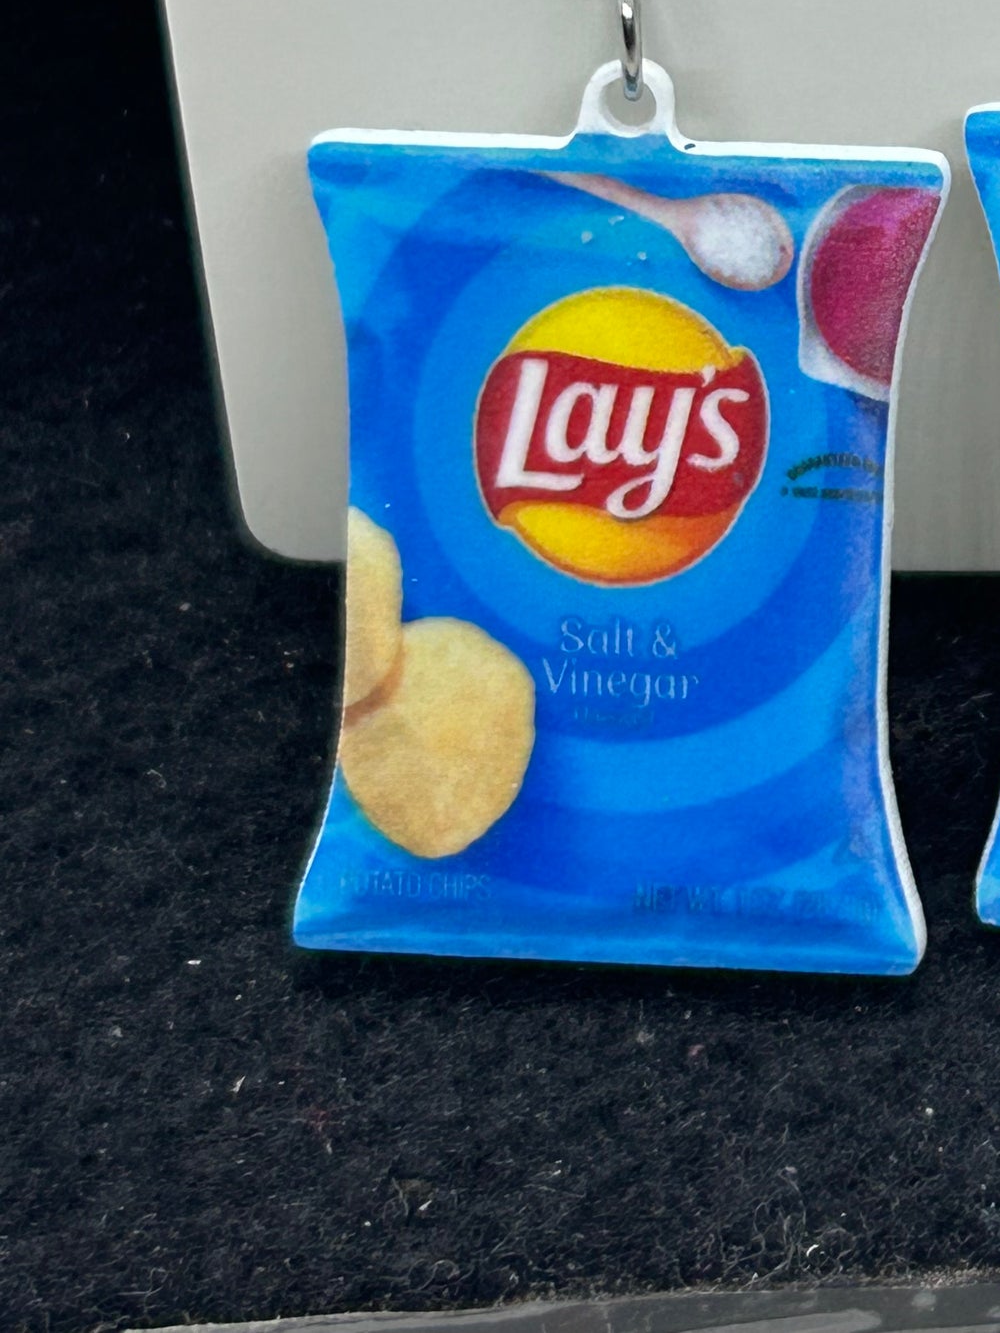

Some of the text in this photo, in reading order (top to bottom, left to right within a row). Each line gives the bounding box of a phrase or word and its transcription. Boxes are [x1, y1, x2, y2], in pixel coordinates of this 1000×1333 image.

[495, 358, 750, 520] Lay's
[560, 617, 678, 659] Salt &
[542, 657, 700, 708] Vinegar
[428, 871, 492, 901] CHIPS
